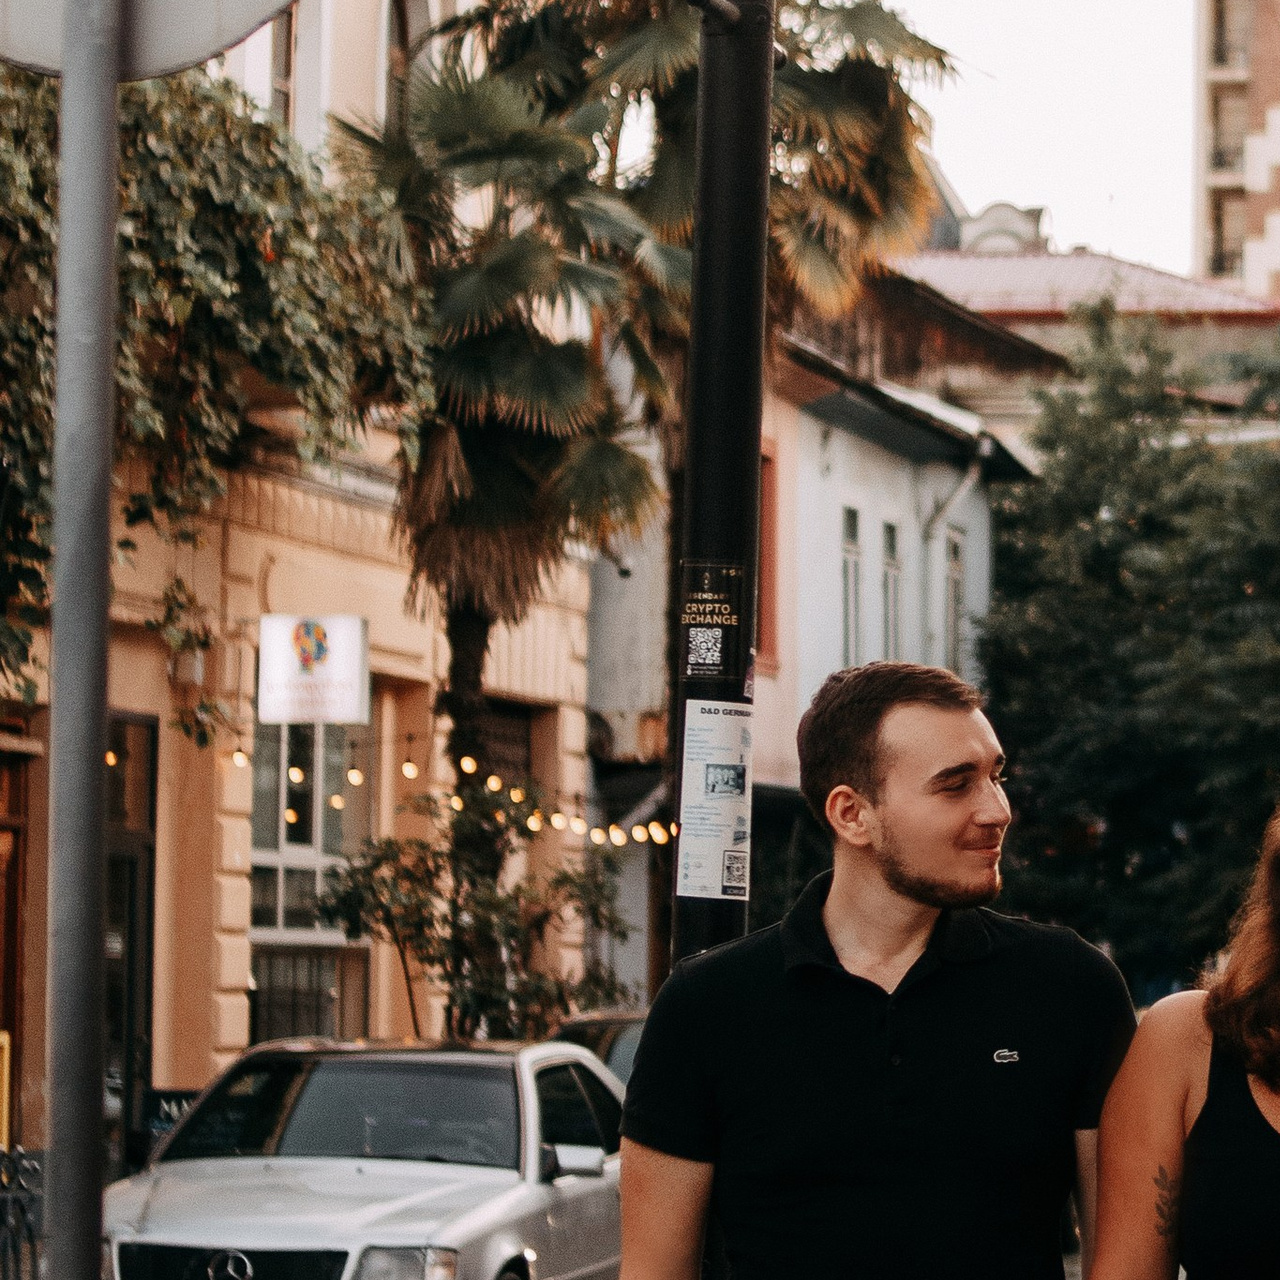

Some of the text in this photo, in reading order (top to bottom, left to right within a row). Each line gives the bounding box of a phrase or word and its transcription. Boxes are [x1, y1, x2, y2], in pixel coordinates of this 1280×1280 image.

[685, 603, 730, 613] CRYPTO
[681, 614, 738, 625] EXCHANGE
[700, 707, 720, 715] D&D
